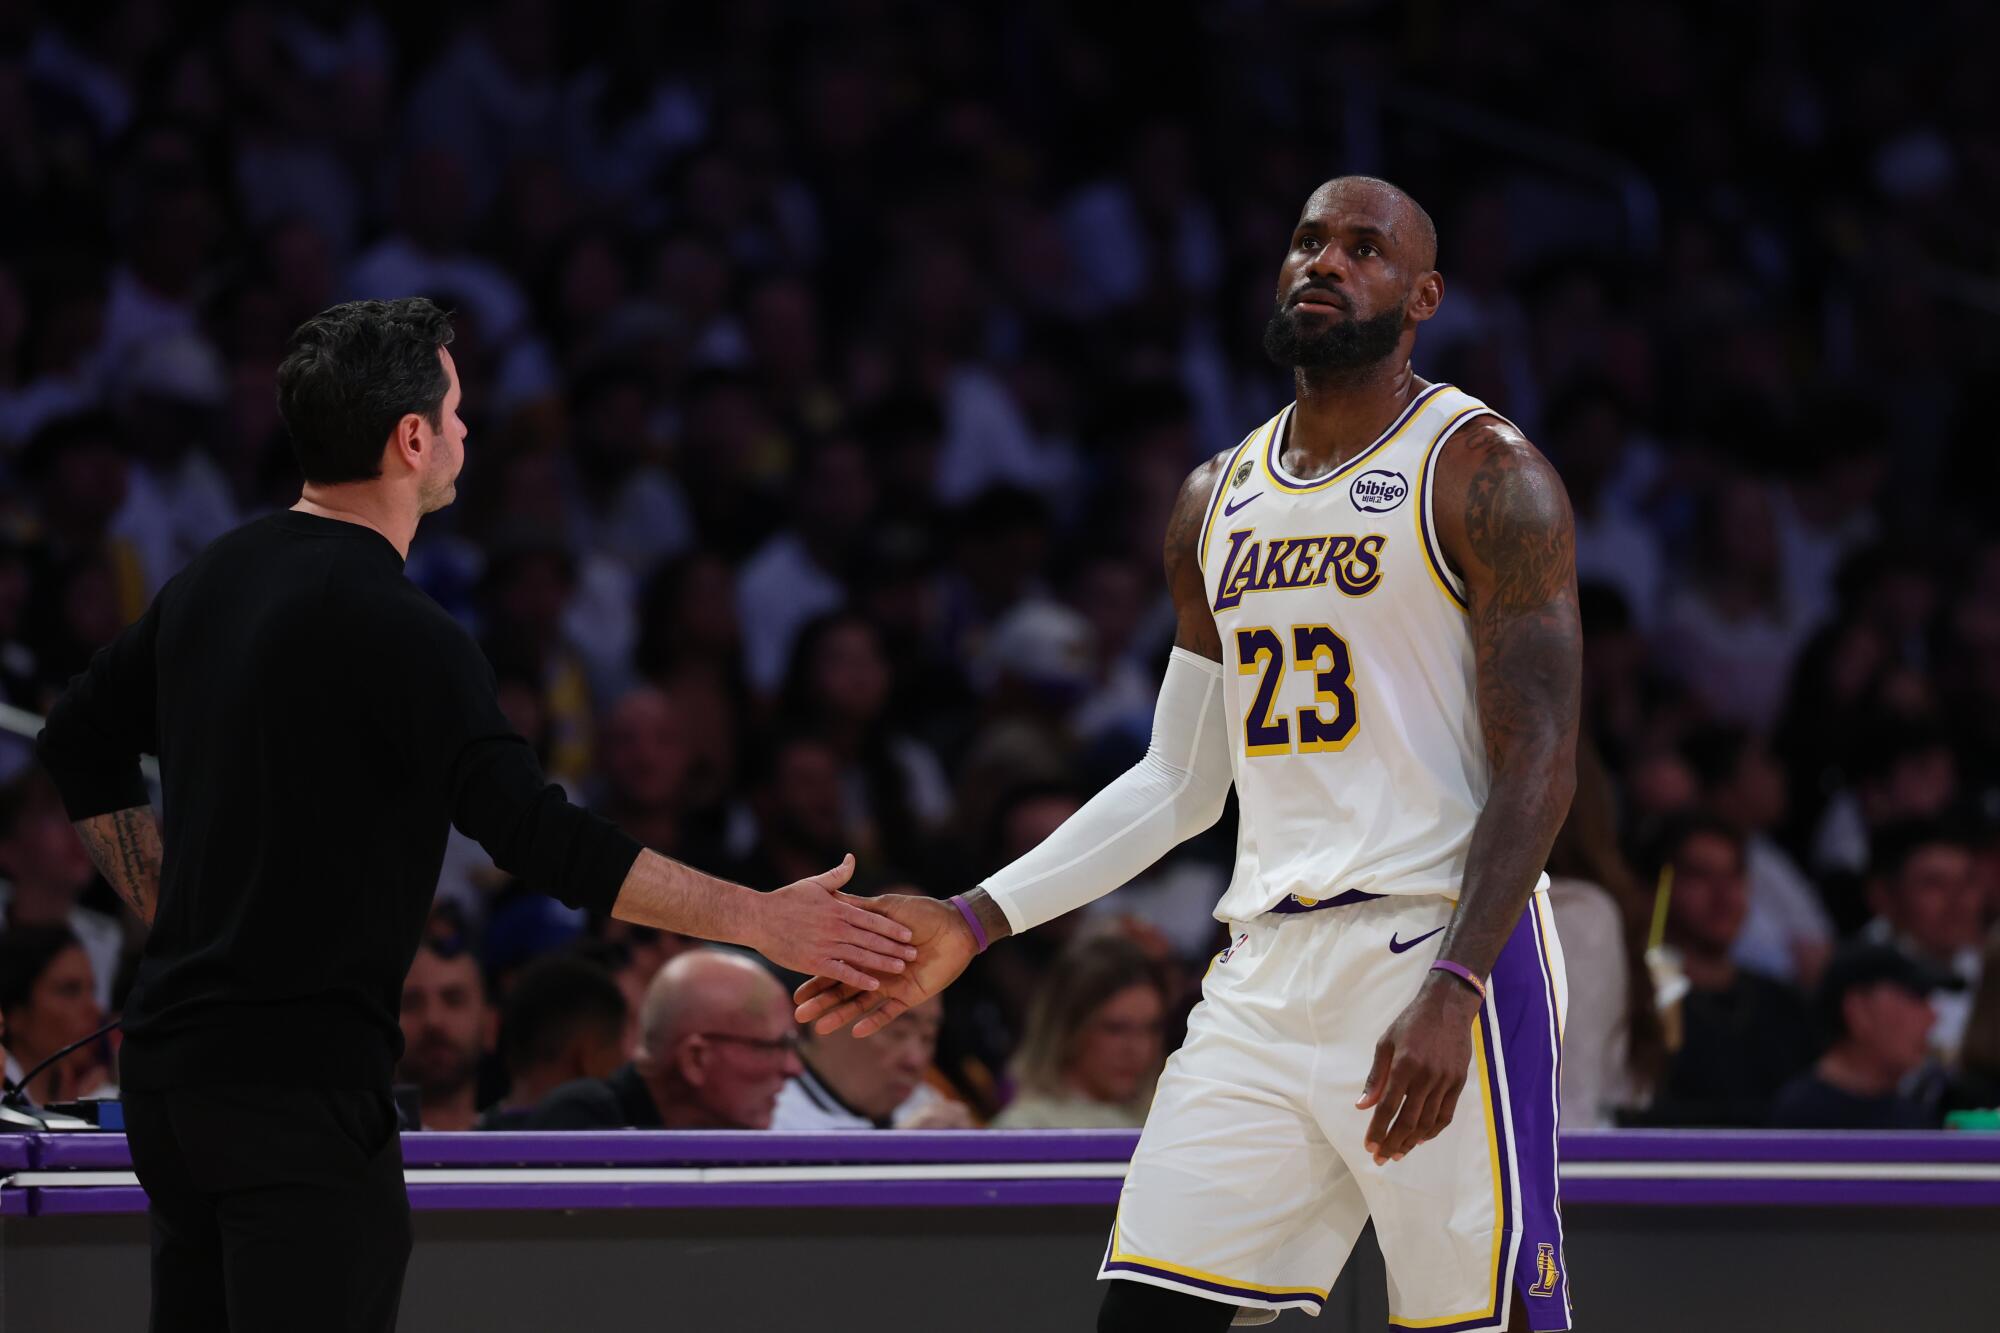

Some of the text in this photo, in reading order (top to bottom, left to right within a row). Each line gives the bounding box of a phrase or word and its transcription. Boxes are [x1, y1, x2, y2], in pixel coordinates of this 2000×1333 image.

[1355, 480, 1405, 501] bibigo
[1362, 495, 1383, 504] 비비고
[1213, 527, 1389, 616] LAKERS
[1234, 623, 1361, 758] 23
